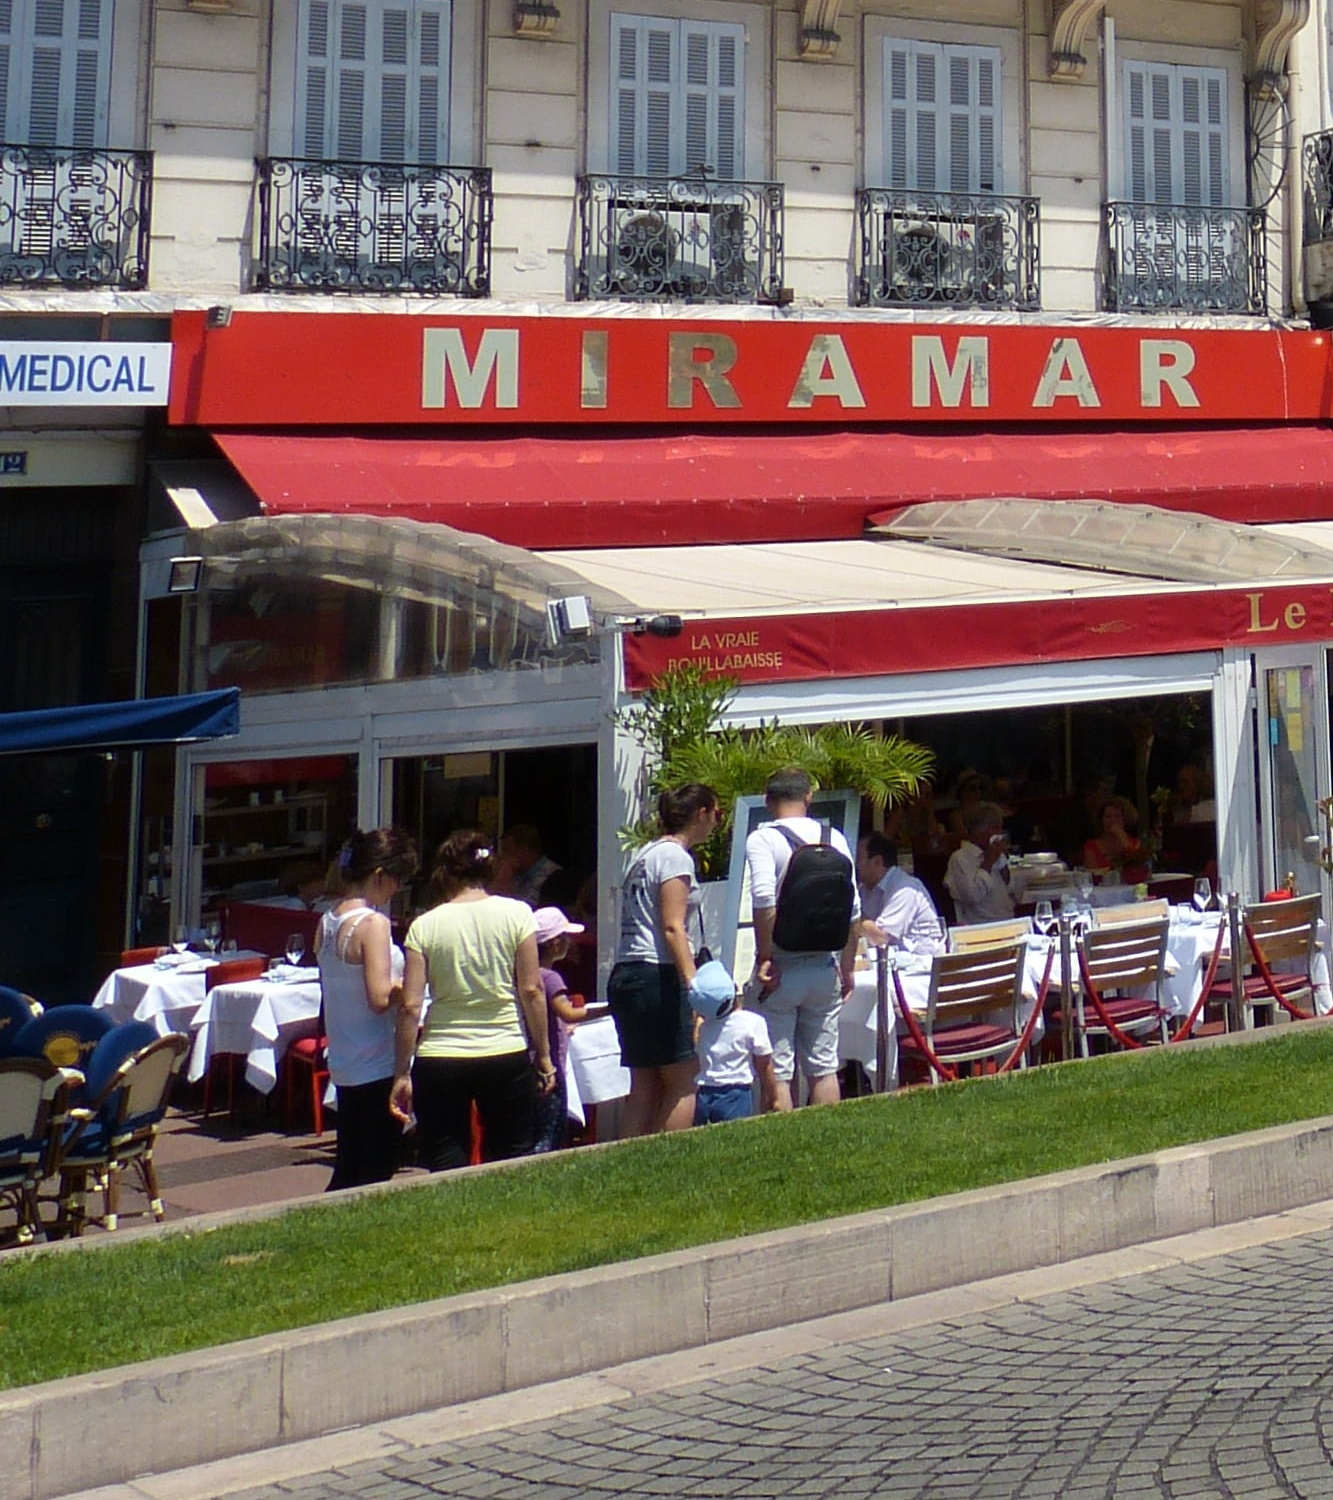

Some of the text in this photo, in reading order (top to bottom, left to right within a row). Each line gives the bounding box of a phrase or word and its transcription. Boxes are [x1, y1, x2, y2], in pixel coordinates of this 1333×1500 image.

[0, 354, 156, 393] MEDICAL
[421, 327, 1201, 410] MIRAMAR
[1246, 592, 1306, 633] Le
[691, 631, 760, 650] LA VRAIE
